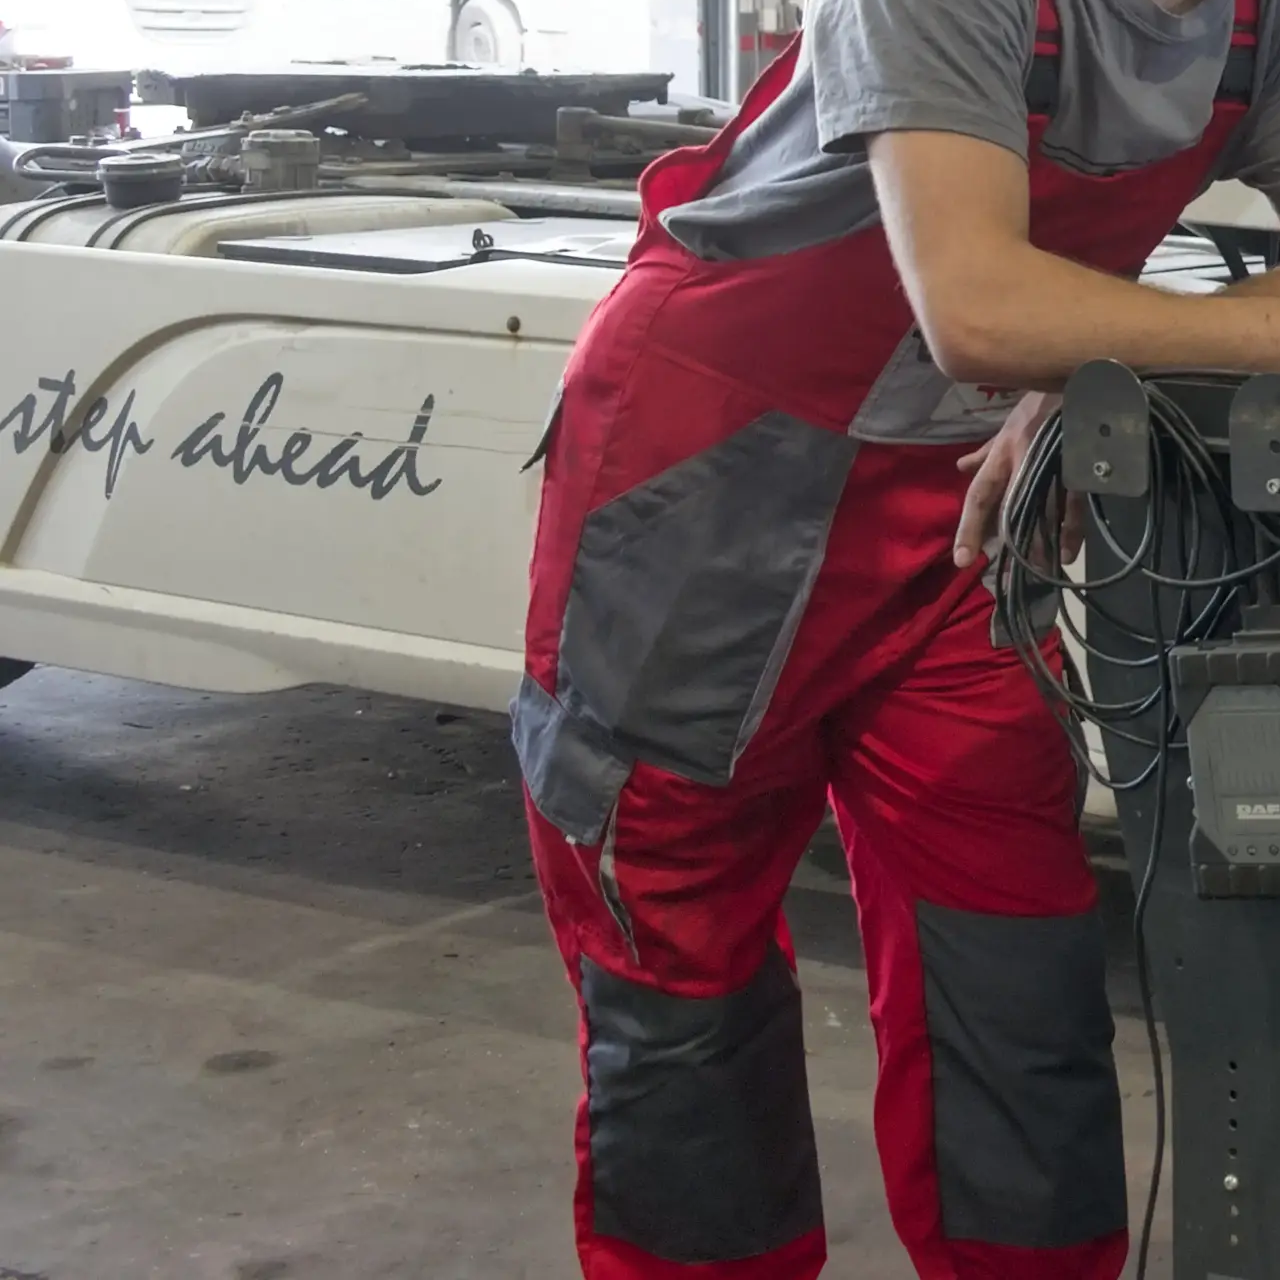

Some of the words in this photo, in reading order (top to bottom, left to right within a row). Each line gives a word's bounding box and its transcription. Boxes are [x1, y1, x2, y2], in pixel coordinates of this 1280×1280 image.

[0, 369, 154, 500] step
[170, 372, 442, 500] ahead
[1236, 804, 1280, 815] DAF
